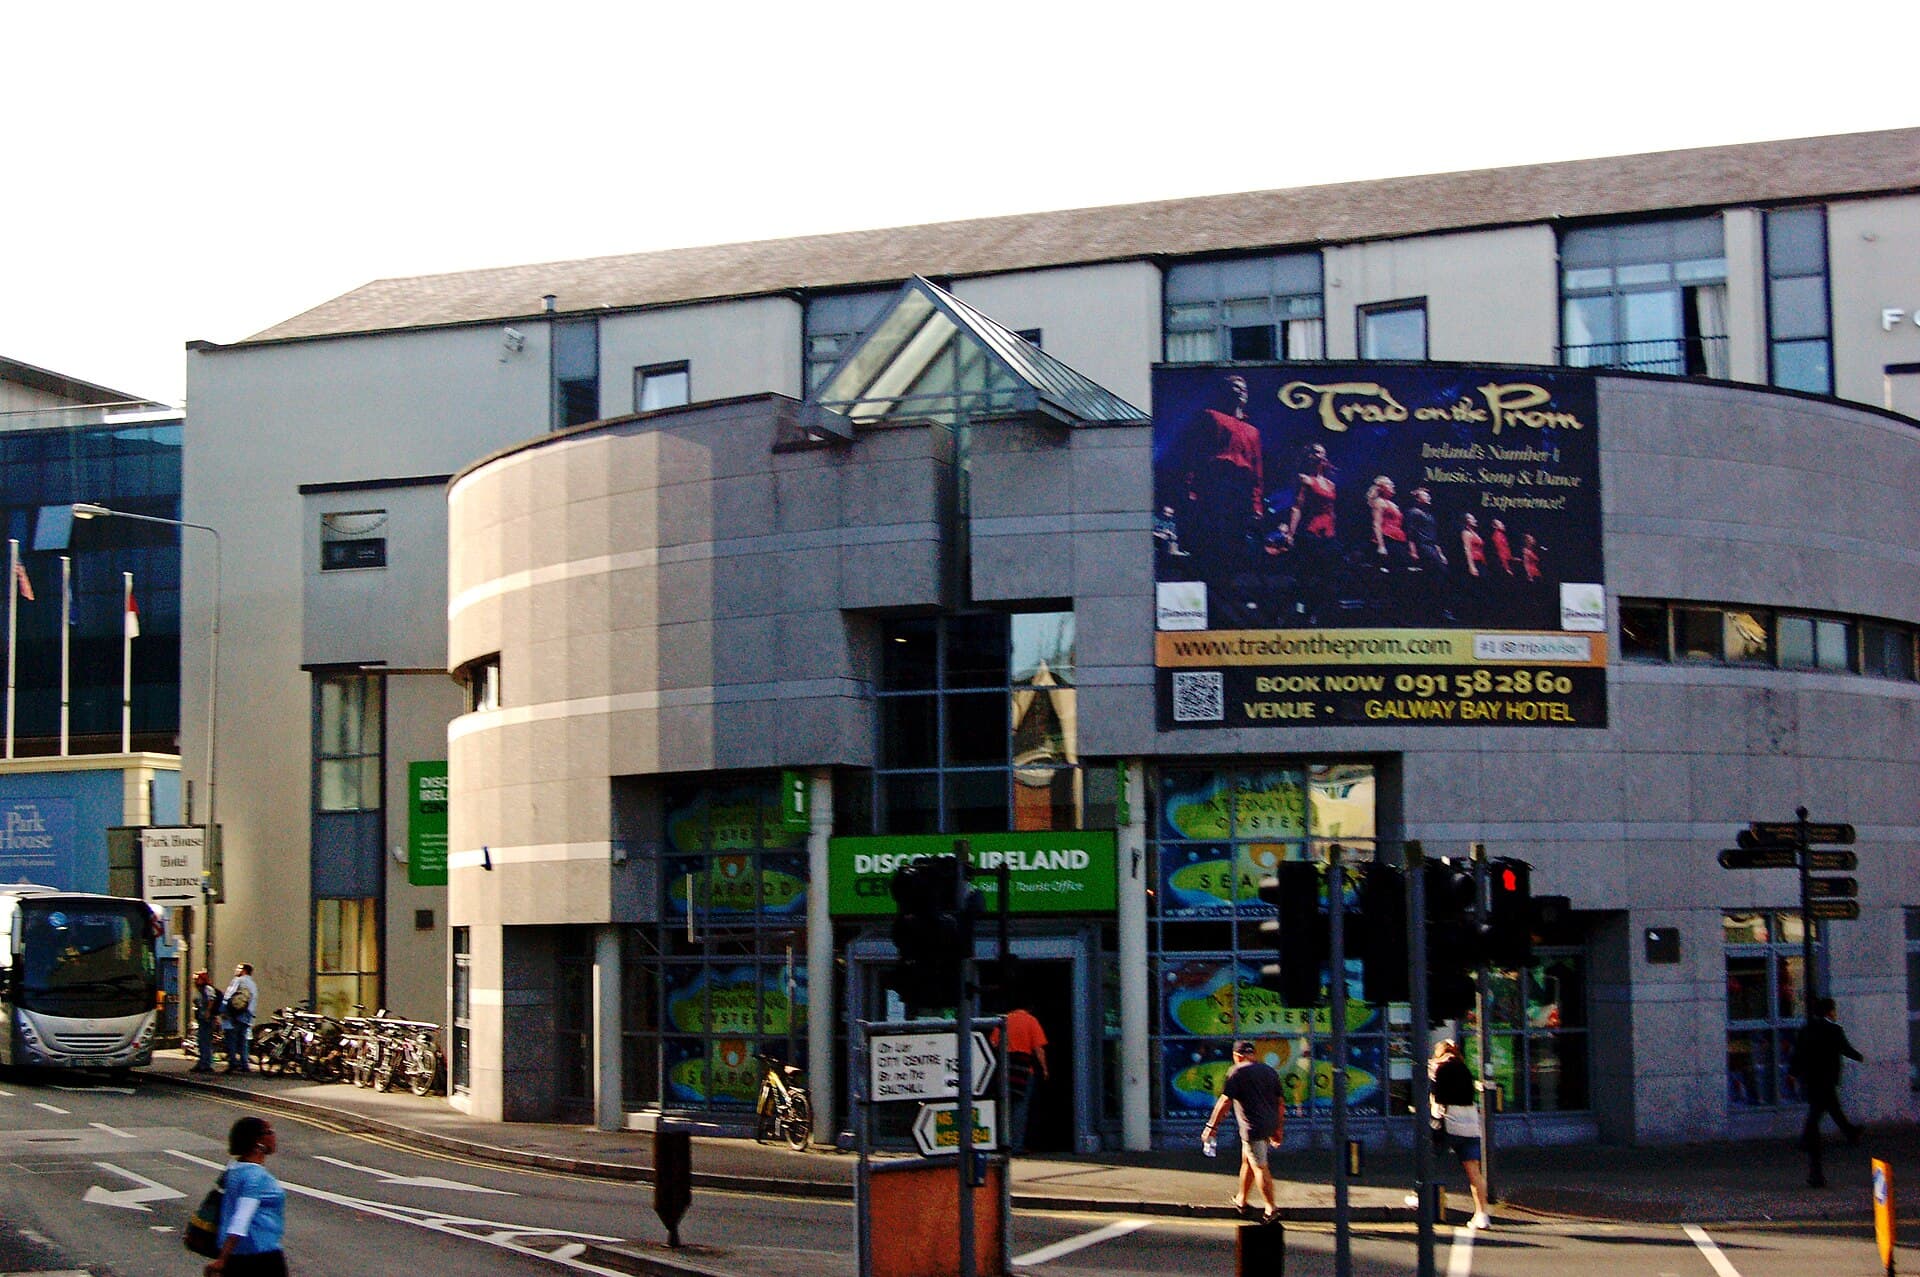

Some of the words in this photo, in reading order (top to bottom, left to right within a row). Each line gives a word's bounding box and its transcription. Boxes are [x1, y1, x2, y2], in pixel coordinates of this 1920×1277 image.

[1882, 308, 1920, 332] F
[1277, 381, 1409, 432] Trad
[1476, 382, 1585, 436] Prom
[1487, 444, 1547, 462] Number
[1518, 471, 1534, 484] &
[1536, 471, 1582, 488] Dance
[1173, 633, 1453, 659] www.tradontheprom.com
[1255, 675, 1322, 693] BOOK
[1324, 675, 1386, 693] NOW
[1394, 673, 1448, 699] 091
[1454, 669, 1574, 699] 582860
[1244, 701, 1316, 720] VENUE
[1364, 698, 1456, 721] GALWAY
[1459, 700, 1505, 720] BAY
[1507, 701, 1577, 722] HOTEL
[6, 810, 47, 833] Park
[144, 835, 171, 848] Park
[172, 834, 205, 847] House
[159, 854, 189, 868] Hotel
[980, 849, 1090, 872] IRELAND
[148, 874, 201, 887] Entrance
[903, 1054, 942, 1067] CENTRE
